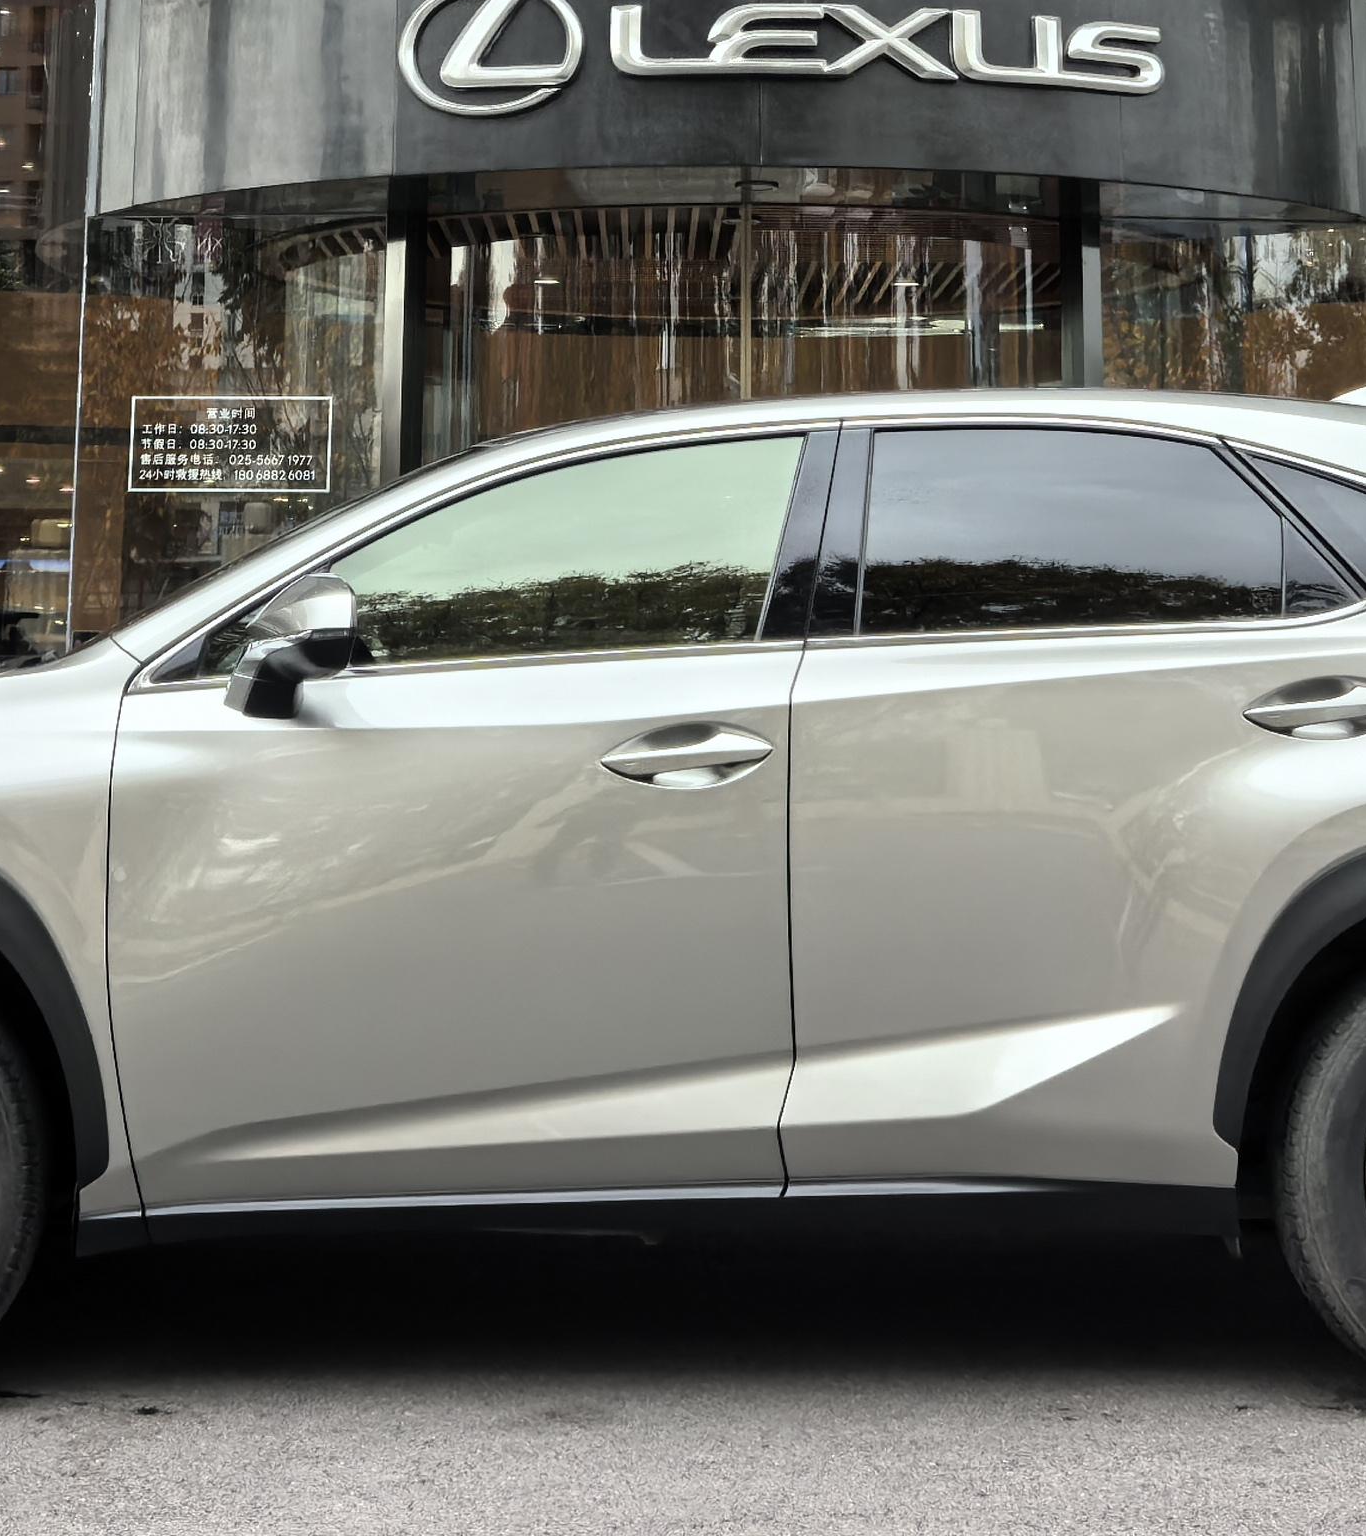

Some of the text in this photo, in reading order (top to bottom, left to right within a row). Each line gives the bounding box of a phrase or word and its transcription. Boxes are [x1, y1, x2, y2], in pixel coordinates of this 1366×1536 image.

[609, 3, 1165, 95] LEXUS
[206, 407, 256, 420] 营业时间
